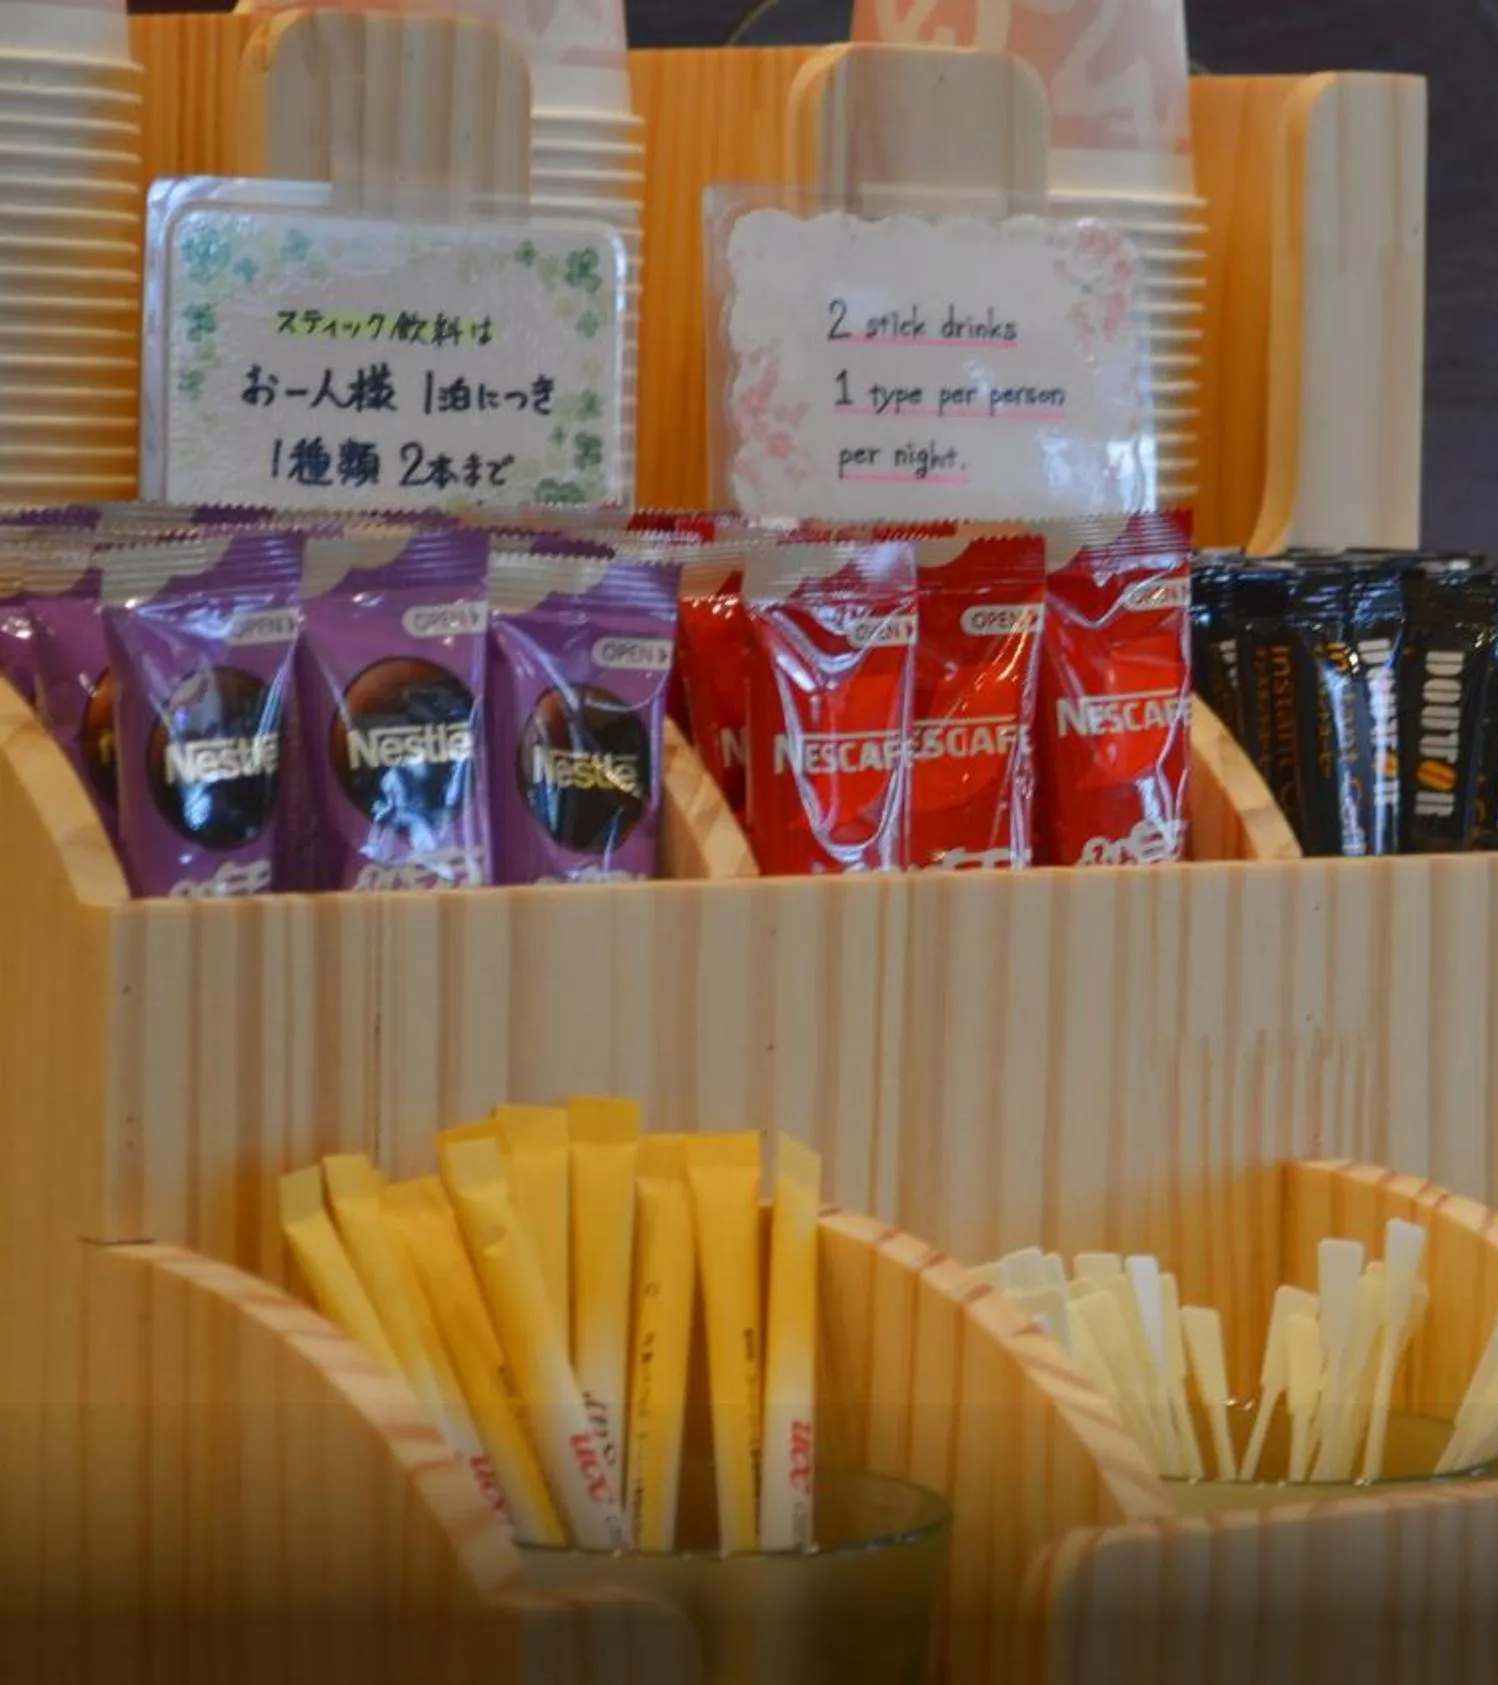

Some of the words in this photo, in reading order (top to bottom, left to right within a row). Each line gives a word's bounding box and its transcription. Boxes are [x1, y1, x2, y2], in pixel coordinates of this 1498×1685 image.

[275, 307, 494, 347] スティック飲料は
[827, 299, 851, 340] 2
[865, 303, 926, 339] stick
[940, 305, 1018, 340] drinks
[240, 361, 399, 414] お一人様
[834, 369, 853, 406] 1
[868, 383, 923, 415] type
[938, 386, 976, 418] per
[989, 385, 1067, 417] person
[399, 445, 517, 490] 2本まで
[838, 445, 880, 480] per
[893, 440, 967, 480] night.
[603, 642, 656, 664] OPEN
[1413, 649, 1465, 817] DOUTOR
